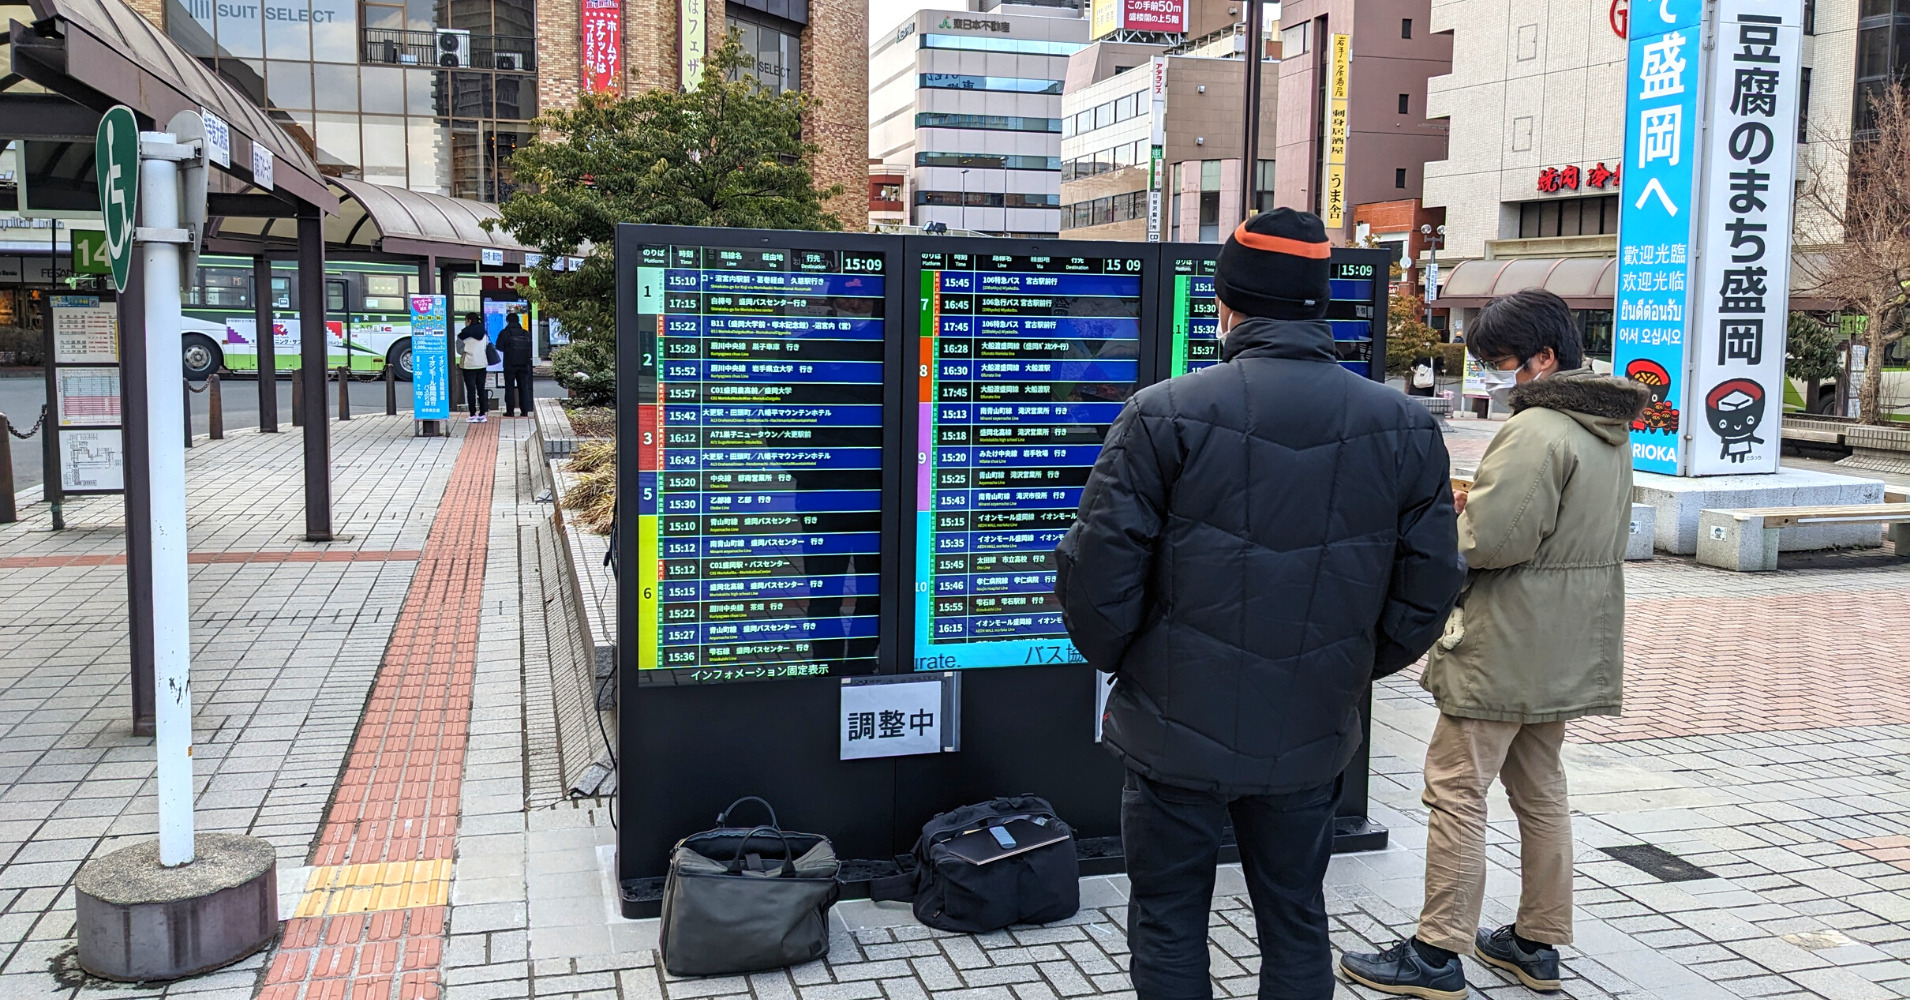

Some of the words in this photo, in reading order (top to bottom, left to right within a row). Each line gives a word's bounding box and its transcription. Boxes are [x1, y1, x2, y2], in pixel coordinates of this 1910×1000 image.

[1128, 0, 1181, 12] この手前50m
[218, 4, 258, 19] SUIT
[266, 7, 335, 23] SELECT
[1129, 13, 1179, 24] 盛楼閣の上5階
[953, 18, 1010, 33] 東日本不動産
[596, 19, 606, 73] チケットは
[758, 61, 791, 79] SELECT
[1331, 109, 1345, 154] 刺身居酒屋
[1537, 165, 1580, 193] 焼肉
[1717, 14, 1782, 366] 豆腐のまち盛岡
[1329, 174, 1342, 219] うま舎
[77, 239, 111, 267] 14
[643, 249, 665, 257] のりば
[679, 250, 694, 258] 時刻
[720, 251, 742, 260] 路線名
[762, 253, 783, 262] 経由地
[806, 254, 821, 263] 行先
[845, 258, 882, 271] 15:09
[1106, 259, 1121, 270] 15
[1126, 260, 1141, 271] 09
[1341, 264, 1373, 276] 15:09
[494, 276, 517, 289] 13
[669, 276, 696, 286] 15:10
[944, 278, 970, 288] 15:45
[1622, 272, 1684, 292] 欢迎光临
[643, 285, 651, 297] 1
[669, 298, 696, 308] 17:15
[738, 298, 807, 307] 盛岡バスセンター行き
[920, 298, 929, 311] 7
[944, 301, 969, 310] 16:45
[1194, 304, 1216, 313] 15:30
[1621, 299, 1682, 321] ยินดีต้อนรับ
[669, 321, 696, 331] 15:22
[944, 322, 969, 332] 17:45
[1193, 325, 1216, 334] 15:32
[1620, 328, 1638, 344] 어서
[1641, 328, 1681, 345] 오십시오
[669, 344, 696, 354] 15:28
[943, 344, 968, 354] 16:28
[1192, 346, 1215, 355] 15:37
[643, 354, 652, 366] 2
[669, 367, 696, 377] 15:52
[919, 365, 928, 377] 8
[943, 366, 968, 376] 16:30
[669, 388, 696, 399] 15:57
[942, 388, 968, 397] 17:45
[669, 411, 696, 421] 15:42
[942, 410, 967, 419] 15:13
[1055, 407, 1068, 415] 行き
[643, 433, 653, 445] 3
[669, 433, 696, 443] 16:12
[942, 431, 967, 441] 15:18
[1054, 428, 1067, 436] 行き
[918, 452, 926, 464] 9
[941, 453, 966, 462] 15:20
[1633, 443, 1677, 463] RIOKA
[669, 455, 696, 465] 16:42
[669, 478, 696, 488] 15:20
[710, 474, 732, 482] 中央線
[778, 474, 792, 482] 行き
[941, 475, 966, 484] 15:25
[1047, 471, 1060, 479] 行き
[643, 488, 652, 500] 5
[669, 500, 696, 509] 15:30
[738, 496, 752, 504] 乙部
[758, 496, 772, 504] 行き
[941, 496, 965, 505] 15:43
[669, 521, 696, 531] 15:10
[744, 517, 798, 525] 盛岡バスセンター
[804, 516, 818, 524] 行き
[940, 518, 965, 527] 15:15
[978, 514, 1035, 522] イオンモール盛岡線
[669, 543, 696, 553] 15:12
[750, 539, 805, 547] 盛岡バスセンター
[940, 539, 965, 548] 15:35
[977, 535, 1034, 543] イオンモール盛岡線
[939, 560, 964, 570] 15:45
[977, 556, 996, 564] 太田線
[1032, 555, 1045, 563] 行き
[669, 565, 696, 575] 15:12
[669, 587, 695, 597] 15:15
[750, 581, 804, 590] 盛岡バスセンター
[810, 580, 823, 588] 行き
[915, 582, 927, 592] 10
[939, 581, 964, 590] 15:46
[643, 588, 652, 600] 6
[939, 603, 963, 612] 15:55
[668, 609, 695, 619] 15:22
[668, 631, 695, 640] 15:27
[743, 624, 797, 633] 盛岡バスセンター
[803, 622, 816, 630] 行き
[938, 624, 962, 633] 16:15
[976, 618, 1032, 627] イオンモール盛岡線
[668, 652, 695, 662] 15:36
[736, 646, 790, 655] 盛岡バスセンター
[796, 644, 809, 652] 行き
[691, 664, 829, 681] インフォメーション固定表示
[848, 708, 934, 741] 調整中
